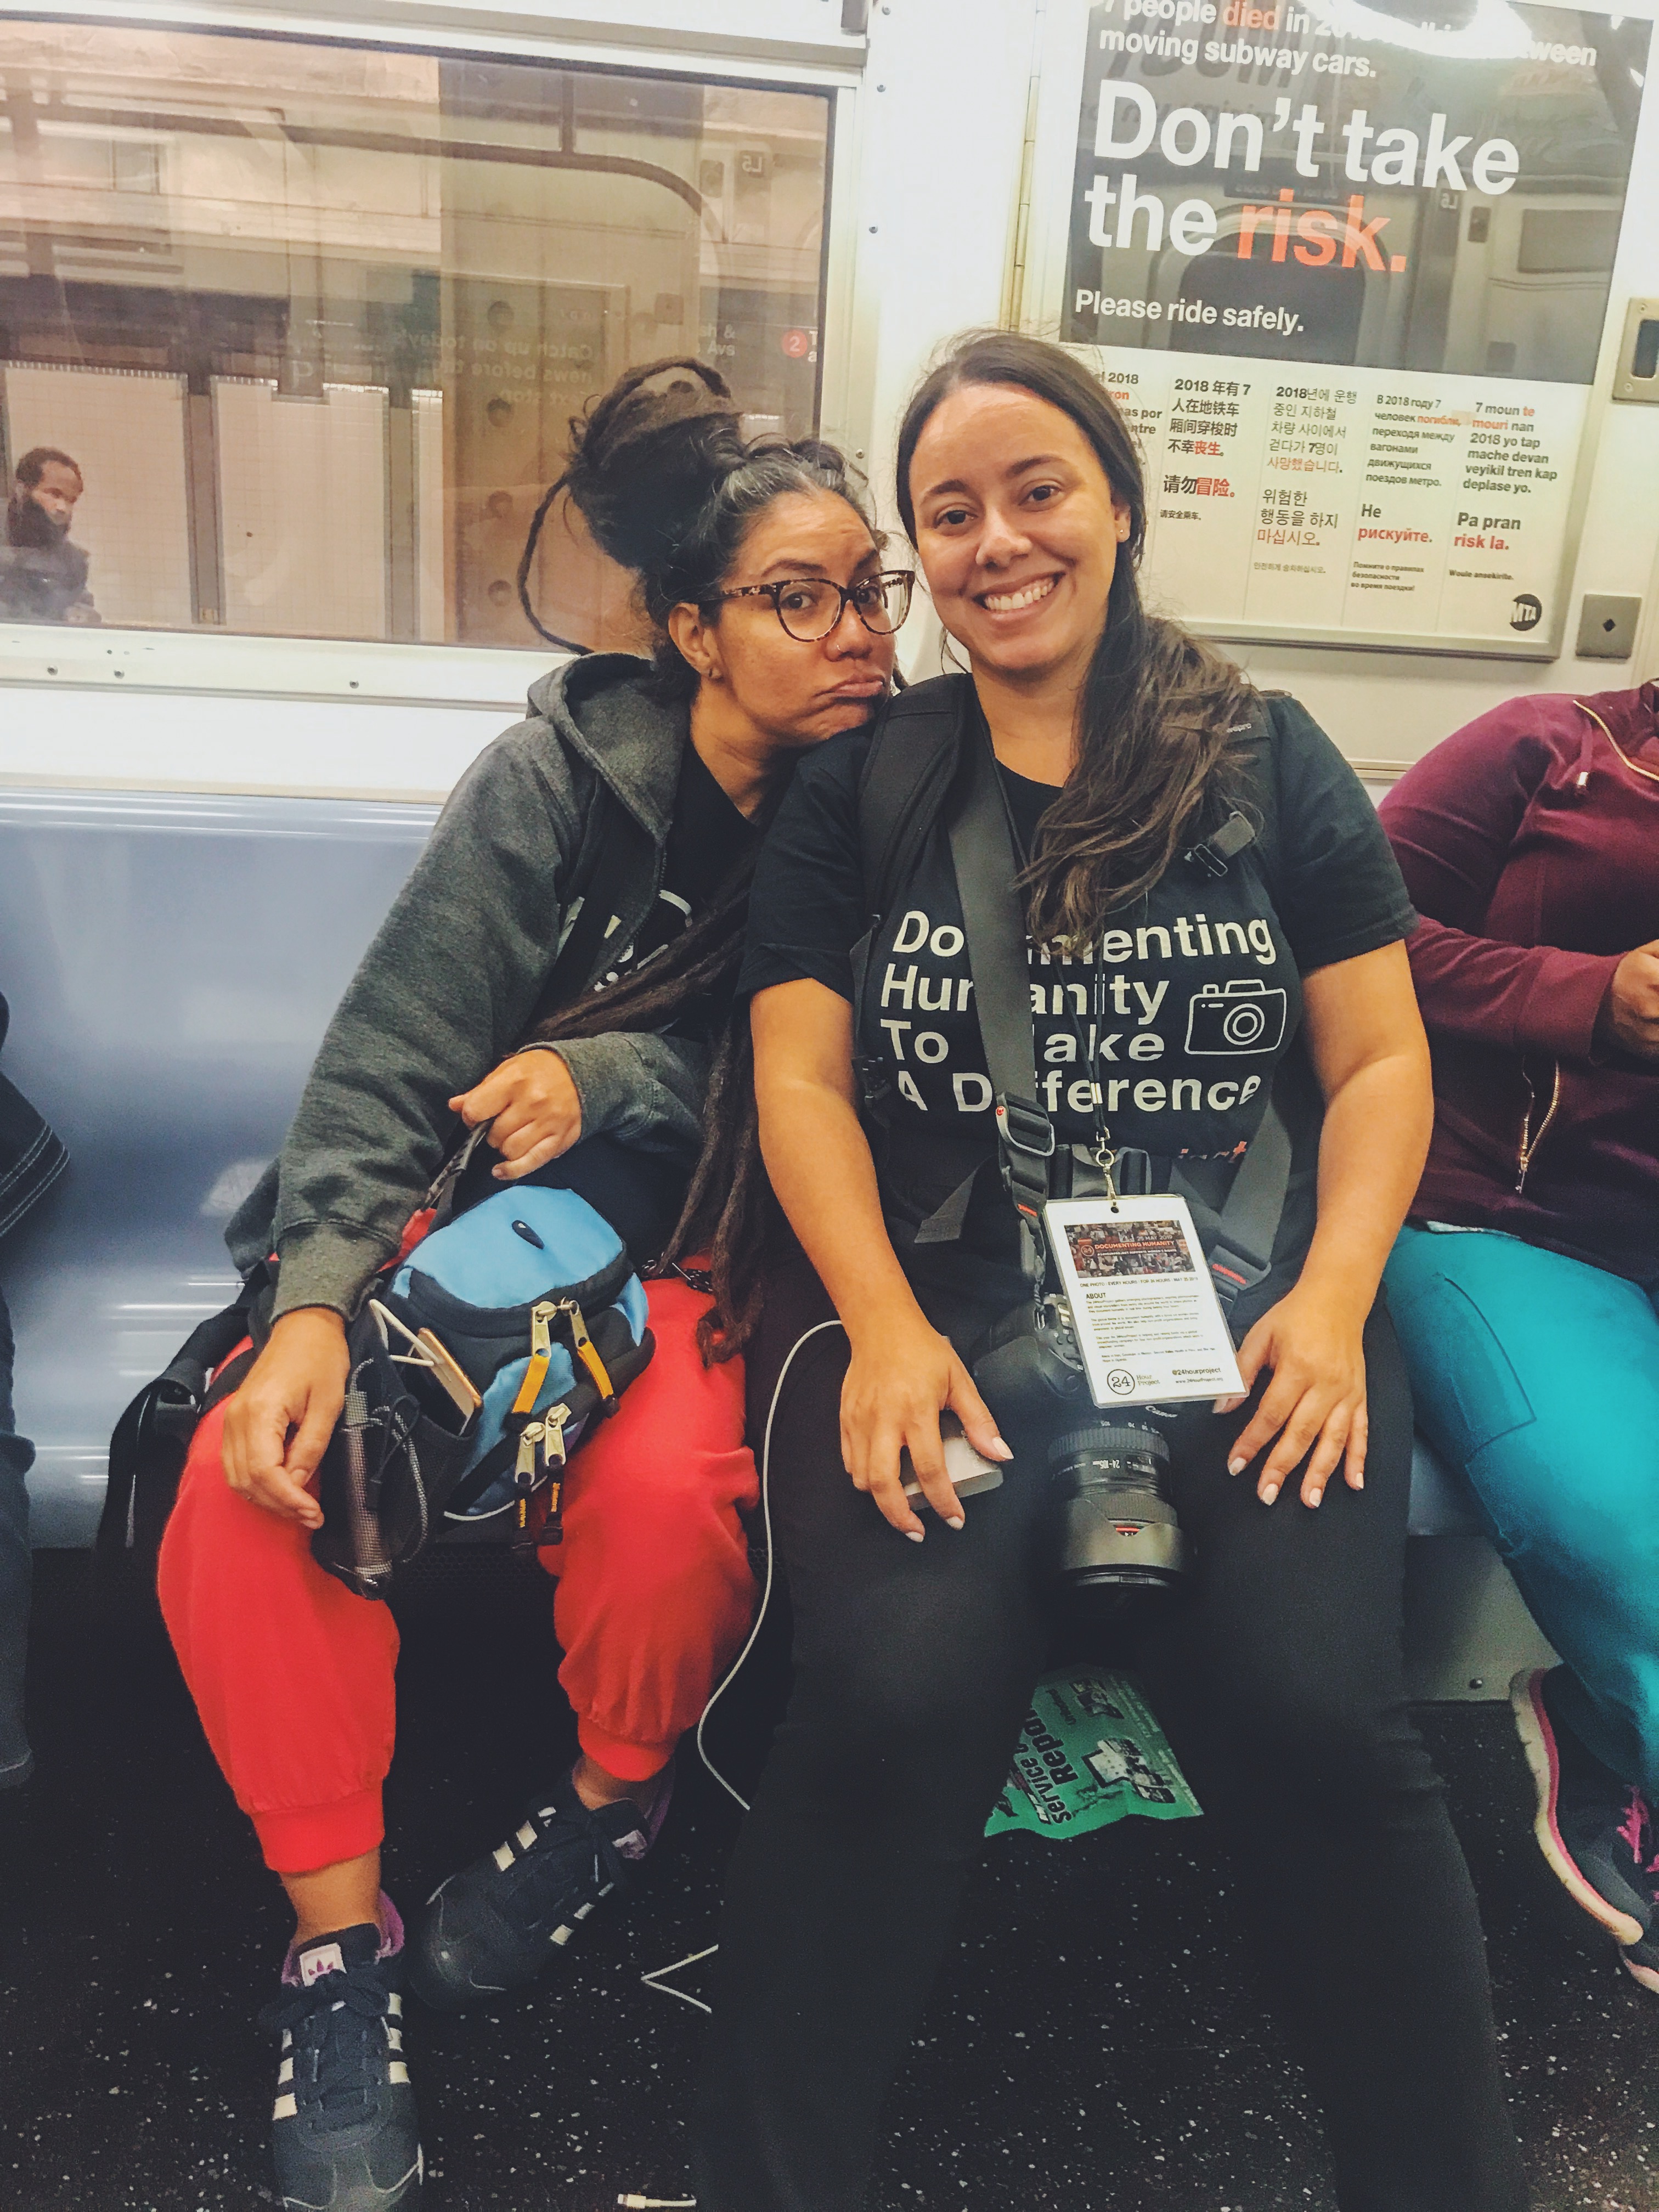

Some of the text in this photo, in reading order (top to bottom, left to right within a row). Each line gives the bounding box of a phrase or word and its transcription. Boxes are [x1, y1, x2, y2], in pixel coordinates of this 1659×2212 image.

[1124, 0, 1217, 26] people
[1223, 5, 1280, 30] died
[1286, 7, 1310, 34] in
[1527, 40, 1598, 66] ween
[1099, 29, 1376, 77] moving subway cars.
[1342, 110, 1519, 195] take
[1084, 174, 1407, 273] the risk.
[1075, 289, 1304, 336] Please ride safely.
[1108, 372, 1139, 384] 2018
[1174, 379, 1251, 396] 2018 年有 7
[1276, 386, 1357, 404] 2018년에 운행
[1171, 399, 1240, 417] 人在地铁车
[1273, 403, 1337, 420] 중인 지하철
[1385, 395, 1409, 407] 2018
[1411, 398, 1434, 410] году
[1435, 399, 1442, 409] 7
[1475, 402, 1535, 417] 7 moun te
[1141, 410, 1163, 420] por
[1375, 412, 1415, 423] человек
[1271, 421, 1346, 439] 차량 사이에서
[1472, 418, 1534, 432] mouri nan
[1372, 427, 1455, 443] переходя между
[1470, 432, 1541, 450] 2018 yo tap
[1268, 439, 1338, 456] 걷다가 7명이
[1370, 443, 1418, 454] вагонами
[1467, 449, 1549, 464] mache devan
[1267, 456, 1343, 473] 사망했습니다.
[1465, 464, 1558, 482] veyikil tren kap
[1163, 475, 1235, 498] 请勿冒险。
[1365, 473, 1407, 485] поездов
[1463, 478, 1532, 494] deplase yo.
[1262, 488, 1307, 507] 위험한
[1260, 508, 1339, 529] 행동을 하지
[1457, 511, 1521, 531] Pa pran
[1257, 528, 1321, 546] 마십시오.
[1357, 527, 1432, 544] рискуйте.
[1453, 533, 1510, 550] risk la.
[892, 910, 1276, 964] Domenting
[881, 963, 1170, 1025] Huanity
[880, 1019, 1165, 1064] To ake
[952, 1070, 1261, 1113] Dference
[1094, 1242, 1142, 1250] DOCUMENTING
[1111, 1375, 1131, 1387] 24
[1020, 1756, 1073, 1824] Service
